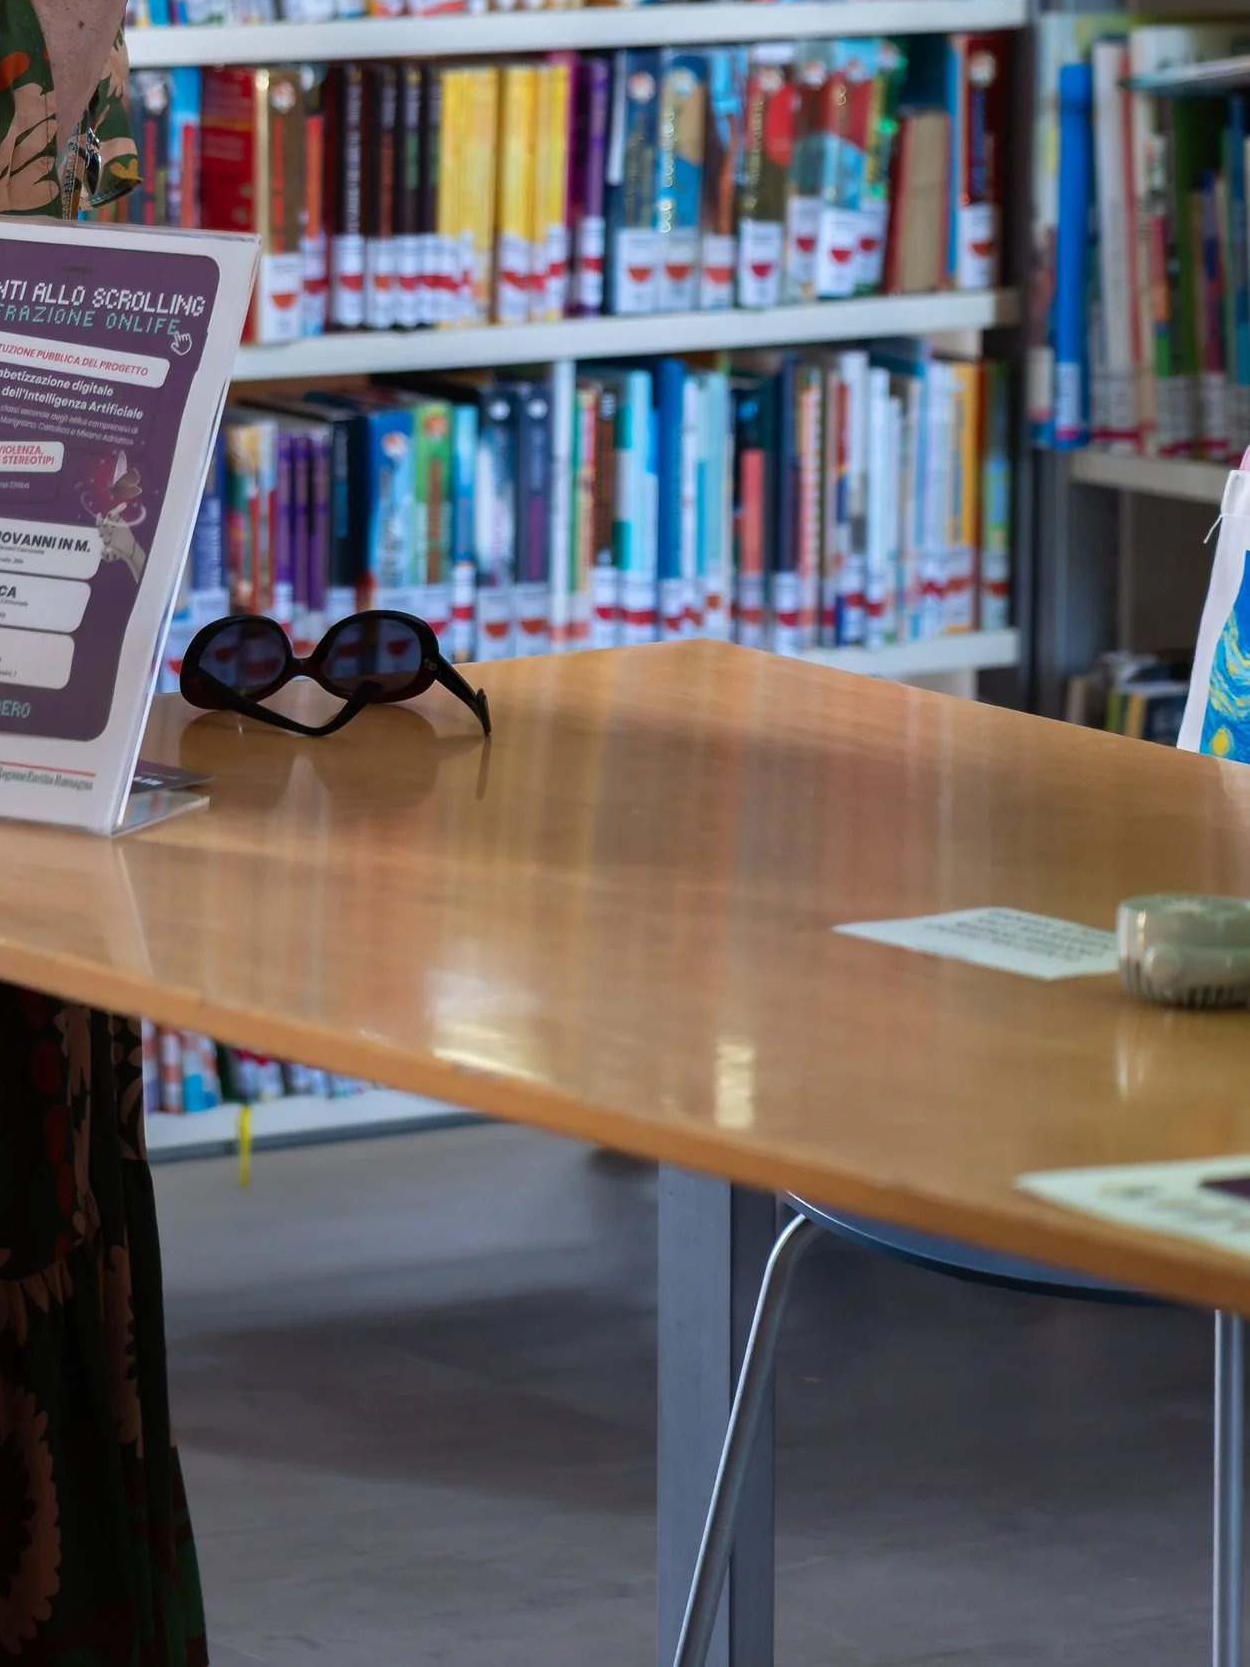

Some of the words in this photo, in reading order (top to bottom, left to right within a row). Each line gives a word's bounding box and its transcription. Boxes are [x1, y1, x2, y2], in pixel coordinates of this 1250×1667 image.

[32, 282, 86, 306] ALLO
[92, 287, 206, 317] SCROLLING
[105, 312, 181, 336] ONLIFE
[36, 349, 81, 366] PUBBLICA
[82, 357, 100, 369] DEL
[99, 359, 149, 377] PROGETTO
[71, 379, 114, 397] digitale
[1, 385, 87, 412] dell'Intelligenza
[88, 401, 144, 421] Artificiale
[2, 455, 55, 466] STEREOTIPI
[58, 538, 73, 551] IN
[74, 540, 91, 553] M.
